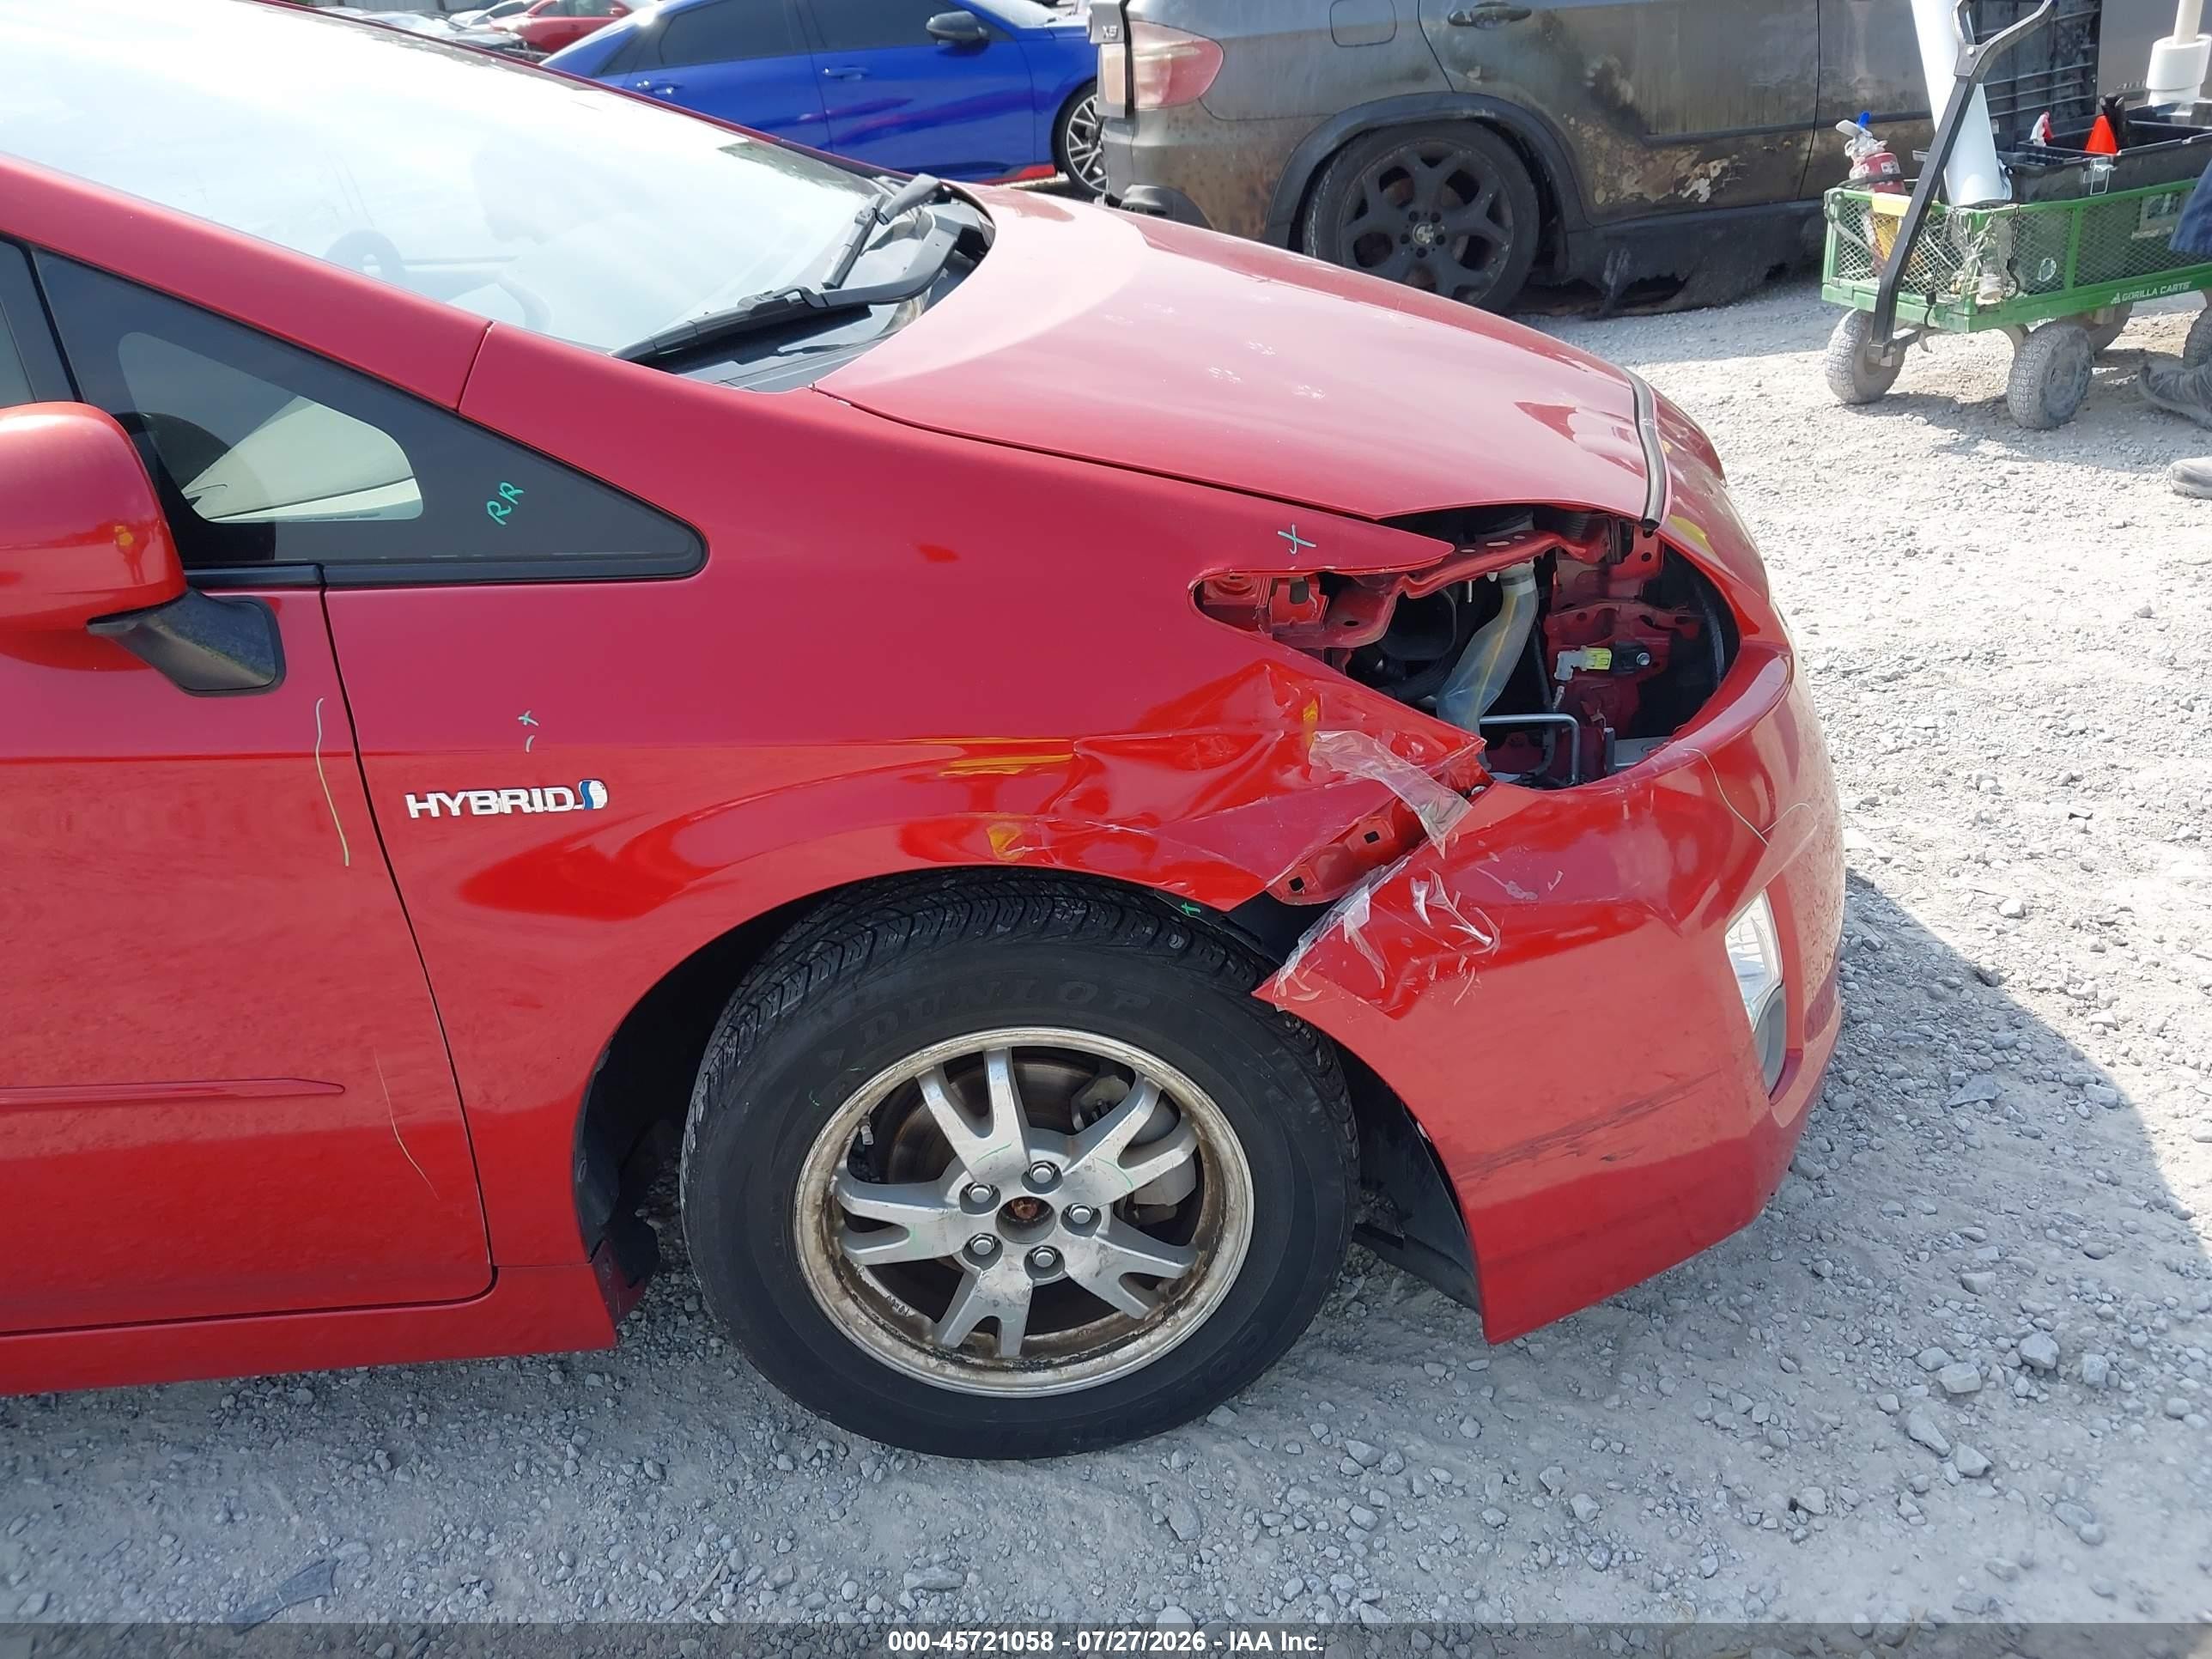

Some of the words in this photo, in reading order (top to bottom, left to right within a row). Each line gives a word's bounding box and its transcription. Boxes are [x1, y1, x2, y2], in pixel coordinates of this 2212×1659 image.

[2122, 288, 2158, 302] GORILLA
[487, 482, 524, 526] RR
[404, 786, 575, 818] HYBRID
[859, 978, 1153, 1042] DUNLOP
